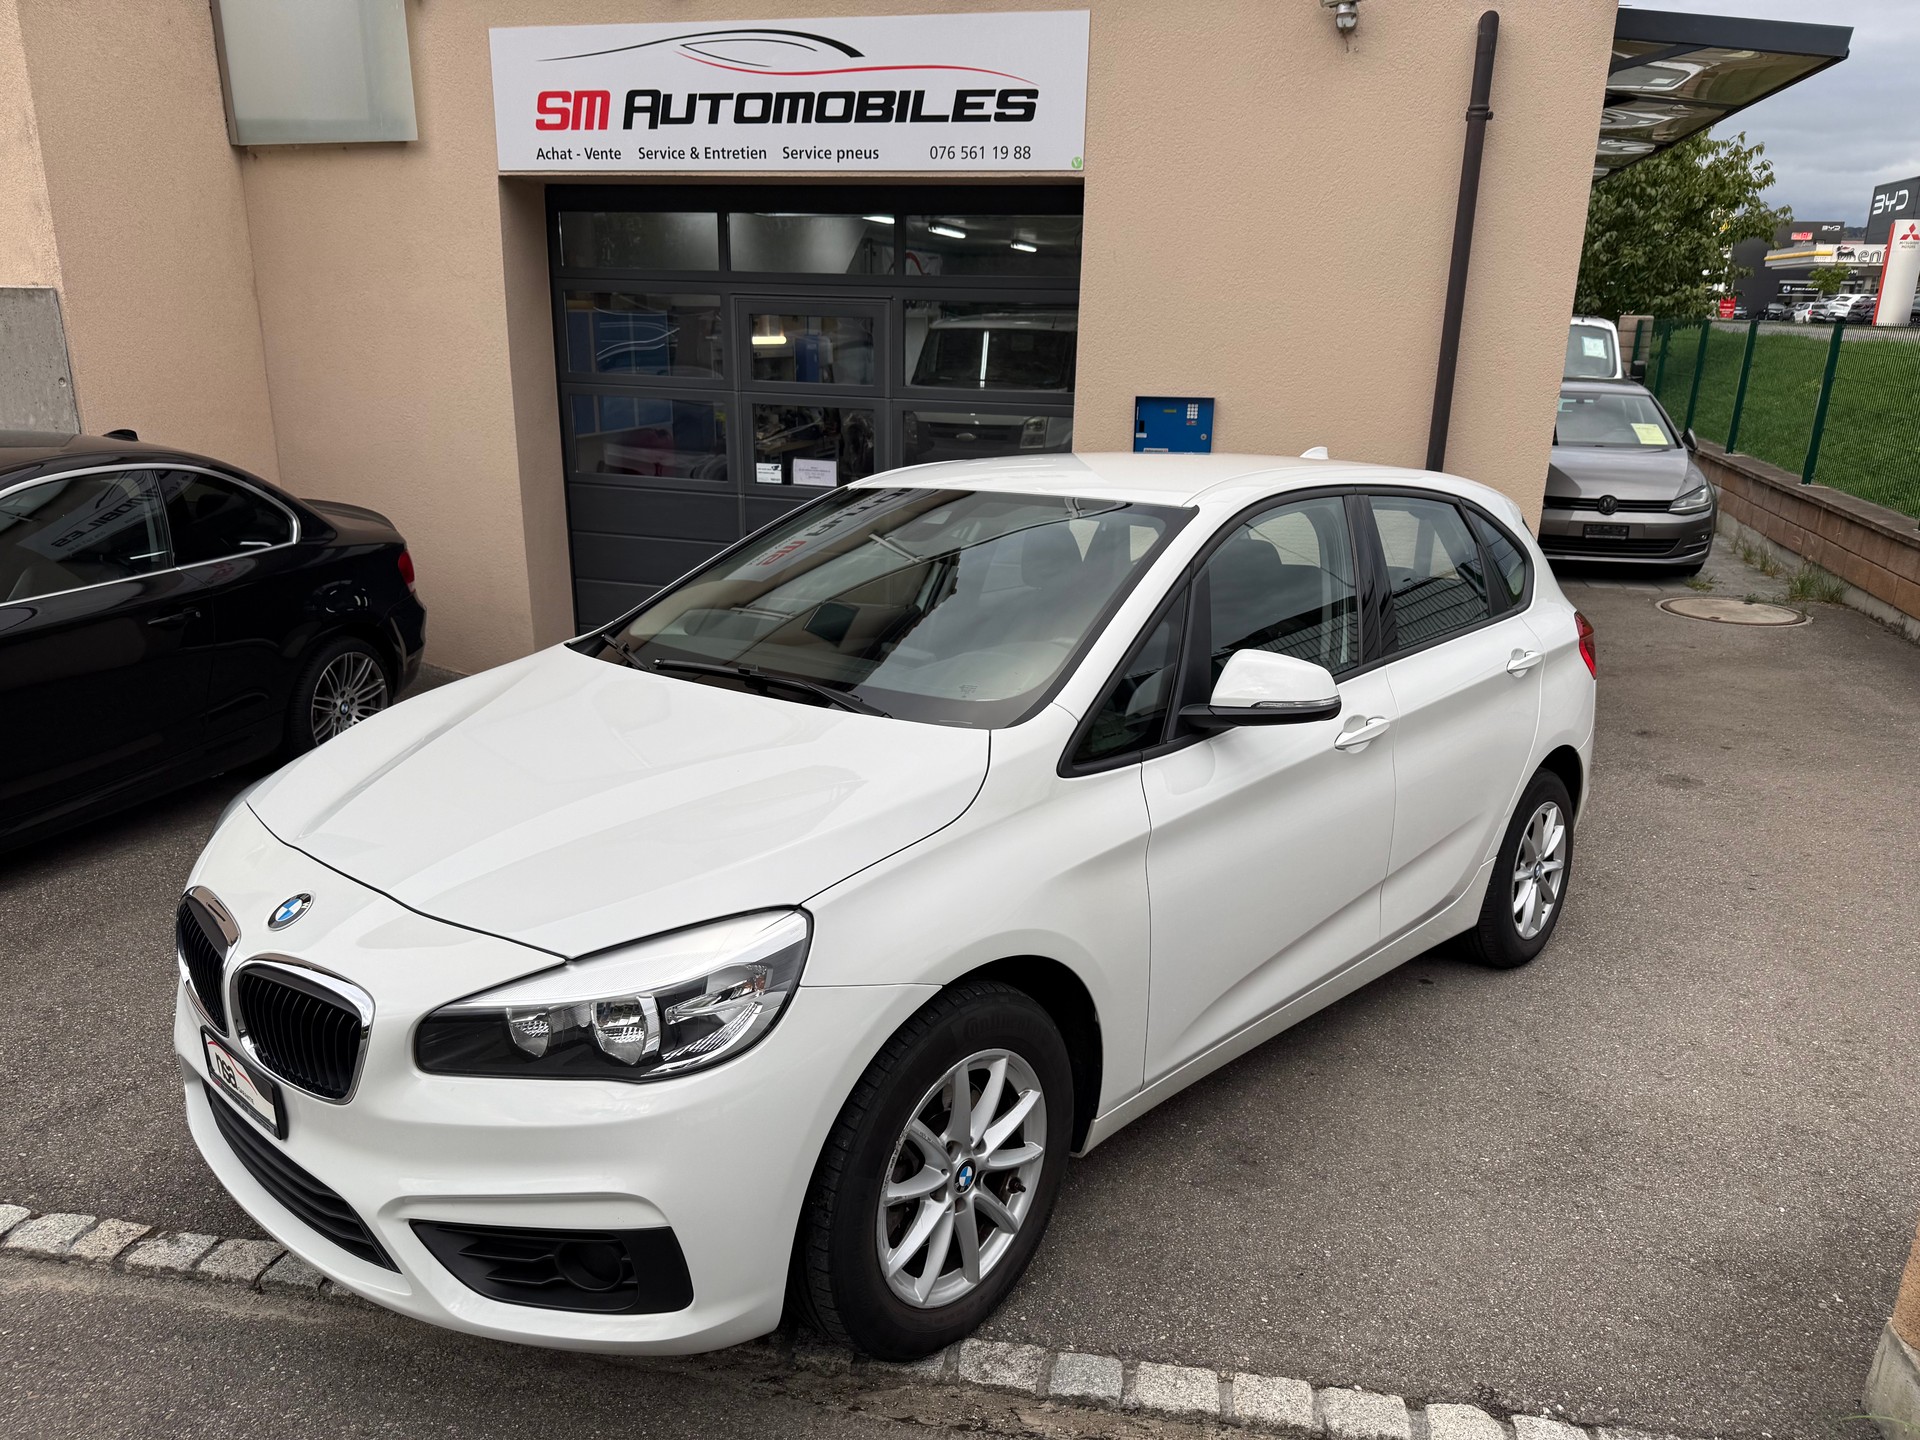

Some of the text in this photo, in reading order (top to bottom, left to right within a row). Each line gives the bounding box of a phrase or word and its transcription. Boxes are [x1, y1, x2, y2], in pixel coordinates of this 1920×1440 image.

[536, 88, 1039, 131] SM AUTOMOBILES
[536, 147, 572, 160] Achat
[584, 147, 622, 160] Vente
[638, 147, 686, 160] Service
[689, 147, 700, 160] &
[704, 146, 767, 160] Entretien
[782, 146, 832, 160] Service
[836, 148, 880, 163] pneus
[929, 146, 1031, 160] 076 561 19 88
[1872, 189, 1909, 215] BYD
